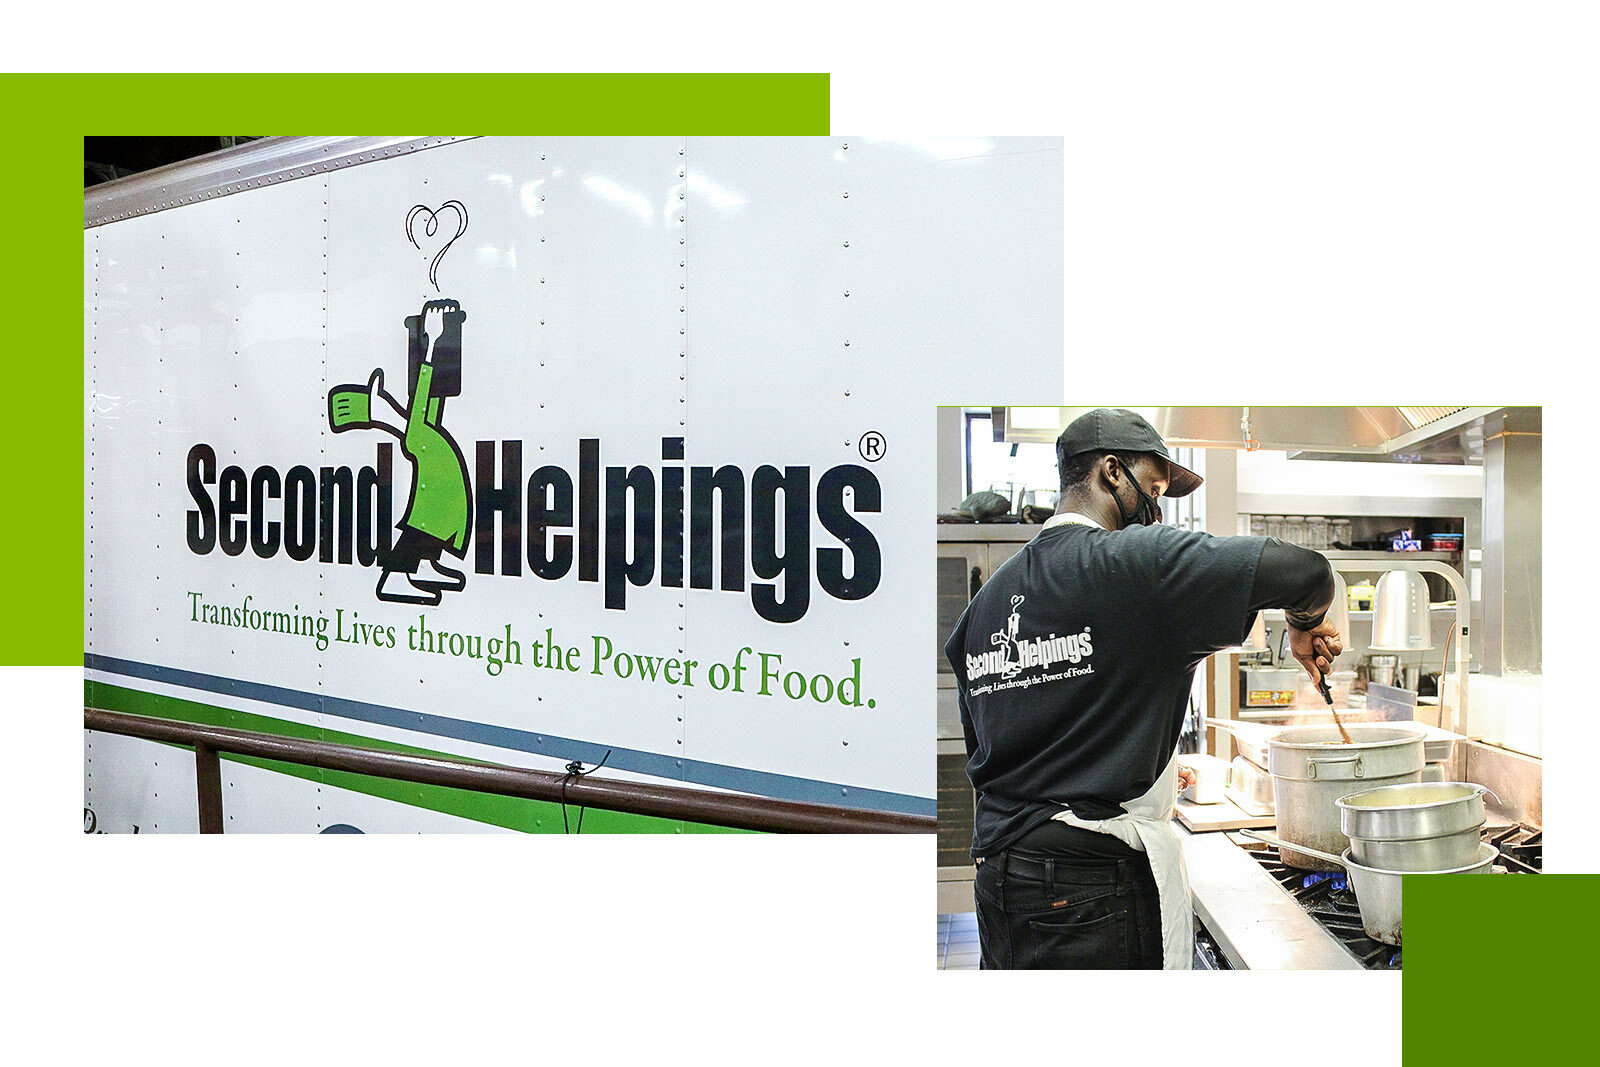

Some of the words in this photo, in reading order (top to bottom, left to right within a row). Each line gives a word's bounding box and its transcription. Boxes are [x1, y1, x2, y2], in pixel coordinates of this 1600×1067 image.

[186, 443, 393, 567] Second
[475, 437, 882, 624] Helpings
[187, 591, 329, 651] Transforming
[335, 608, 396, 648] Lives
[408, 614, 522, 676] through
[532, 628, 580, 672] the
[591, 635, 698, 687] Power
[708, 647, 752, 693] of
[757, 653, 876, 709] Food.
[966, 644, 1006, 681] Second
[1018, 632, 1094, 670] Helpings
[1042, 673, 1063, 683] Power
[1063, 667, 1072, 678] of
